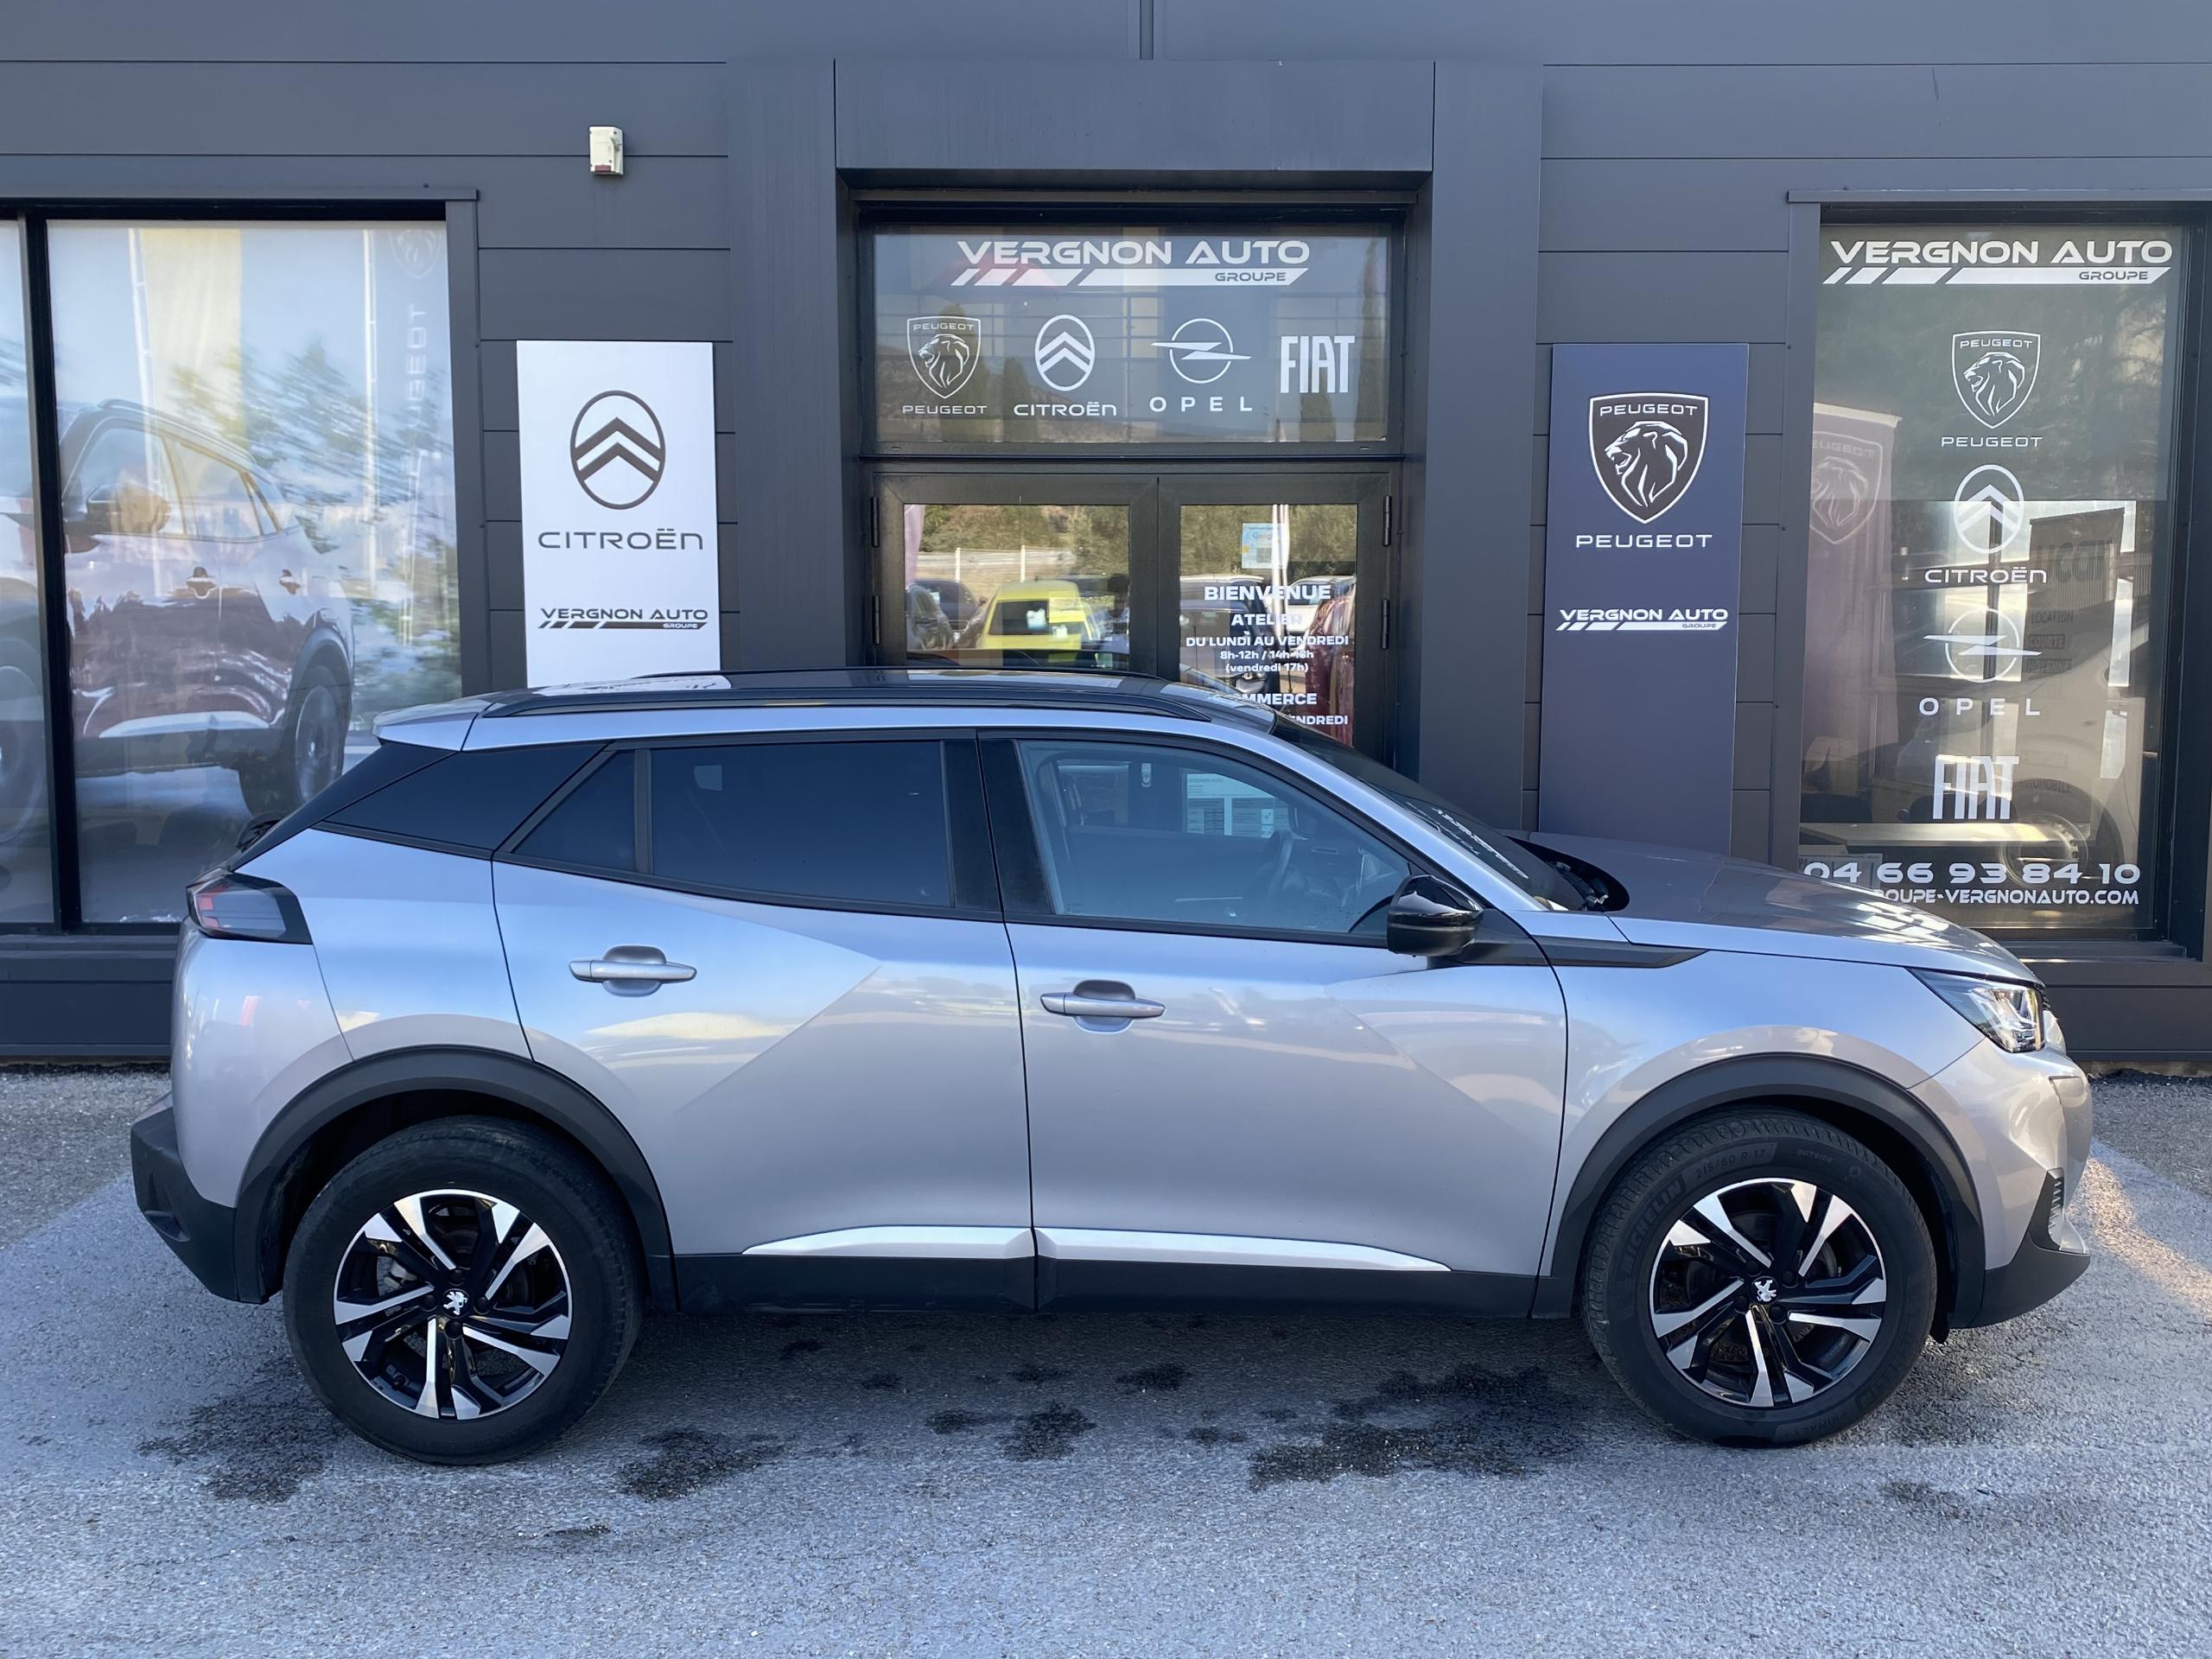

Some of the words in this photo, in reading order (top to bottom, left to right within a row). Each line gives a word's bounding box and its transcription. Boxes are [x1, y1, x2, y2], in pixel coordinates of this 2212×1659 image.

[957, 240, 1172, 264] VERGNON
[1185, 240, 1310, 264] AUTO
[1830, 240, 2039, 264] VERGNON
[2050, 240, 2173, 264] AUTO
[1214, 272, 1287, 282] GROUPE
[2078, 270, 2149, 281] GROUPE
[912, 322, 975, 332] PEUGEOT
[1959, 339, 2033, 348] PEUGEOT
[1280, 335, 1356, 394] FIAT
[902, 404, 988, 415] PEUGEOT
[1599, 404, 1698, 416] PEUGEOT
[1812, 440, 1875, 457] EUGEOT
[1941, 436, 2043, 448] PEUGEOT
[1575, 534, 1713, 549] PEUGEOT
[1204, 585, 1332, 601] BIENVENUE
[540, 607, 643, 620] VERGNON
[649, 608, 709, 620] AUTO
[1231, 613, 1303, 626] ATELIER
[1560, 608, 1663, 621] VERGNON
[1668, 608, 1729, 621] AUTO
[1185, 637, 1206, 647] DU
[1209, 637, 1251, 647] LUNDI
[1254, 636, 1274, 646] AU
[1278, 635, 1349, 646] VENDREDI
[1219, 650, 1260, 660] 8h-12h
[1225, 663, 1281, 674] (vendredi
[1284, 663, 1309, 673] 17h)
[1242, 692, 1318, 705] MMERCE
[1290, 715, 1349, 725] NDREDI
[1932, 753, 2020, 820] FIAT
[1803, 861, 1863, 884] 04
[1876, 862, 1935, 885] 66
[1948, 862, 2007, 885] 93
[2021, 862, 2083, 884] 84
[2100, 863, 2141, 884] 10
[1695, 1154, 1736, 1179] 215/60
[1740, 1150, 1748, 1162] R
[1754, 1148, 1766, 1159] 17
[1618, 1175, 1684, 1275] MICHELIN
